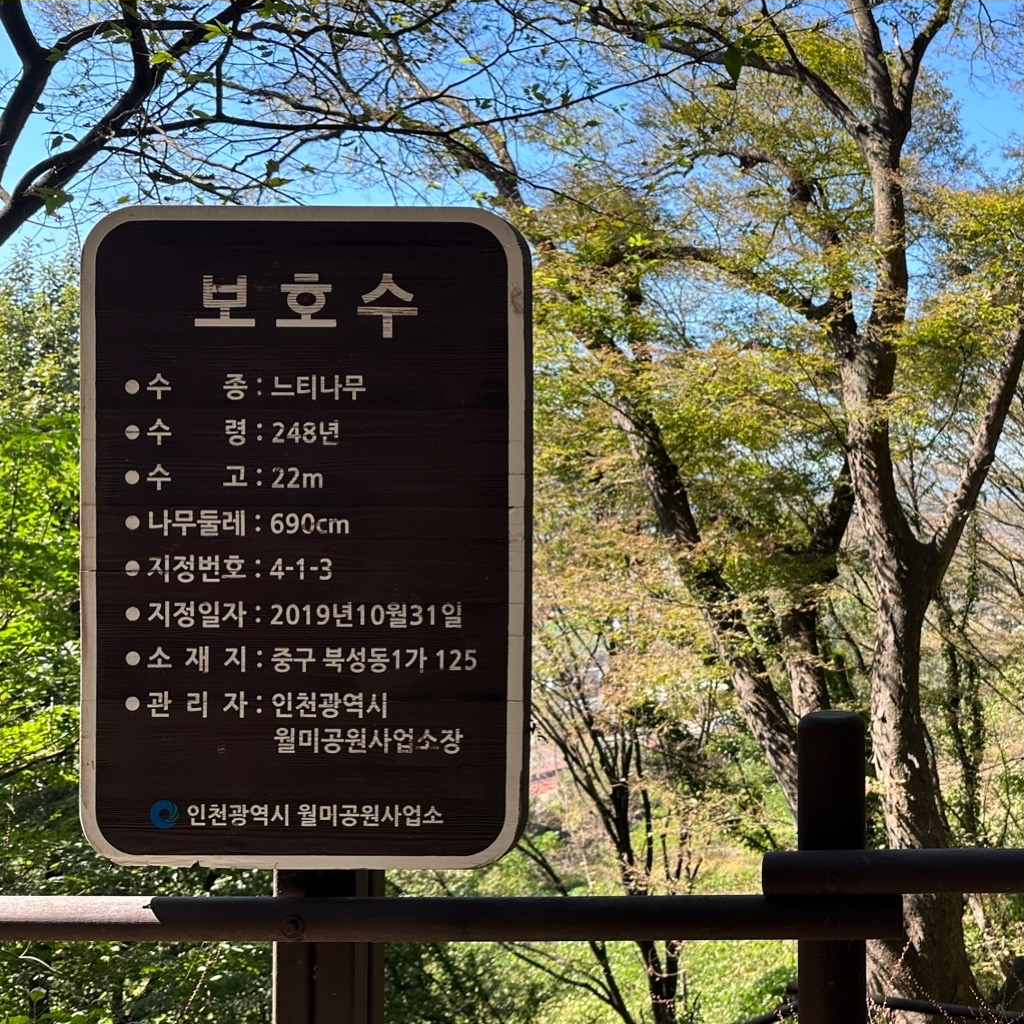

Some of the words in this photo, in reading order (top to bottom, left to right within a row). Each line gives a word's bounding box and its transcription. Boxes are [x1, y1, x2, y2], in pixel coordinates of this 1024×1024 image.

[271, 374, 367, 401] 느티나무
[271, 420, 340, 446] 248년
[271, 466, 324, 489] 22m
[270, 512, 350, 535] 690cm
[269, 557, 333, 581] 4-1-3
[270, 601, 463, 629] 2019년10월31일
[270, 647, 317, 673] 중구
[322, 646, 428, 674] 북성동1가
[435, 649, 477, 671] 125
[271, 691, 388, 719] 인천광역시
[273, 727, 464, 755] 월미공원사업소장
[186, 803, 290, 827] 인천광역시
[296, 803, 444, 828] 월미공원사업소
